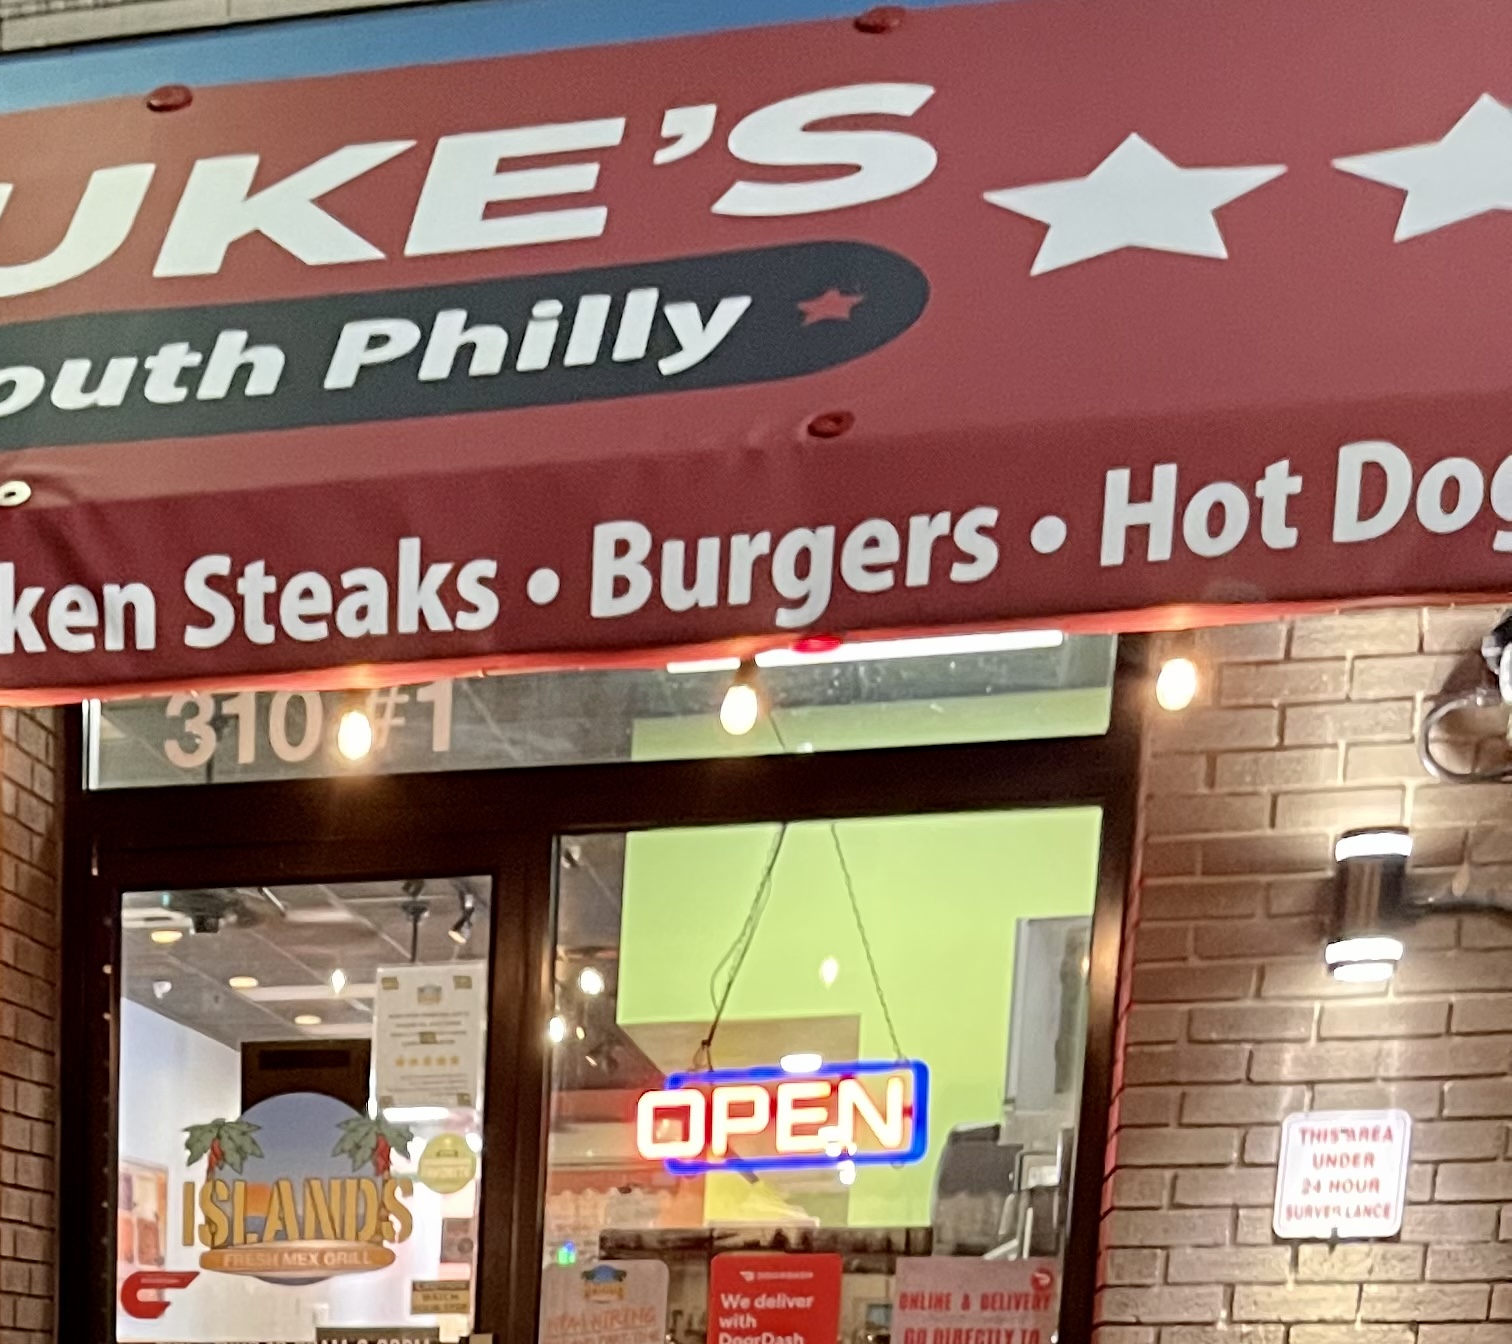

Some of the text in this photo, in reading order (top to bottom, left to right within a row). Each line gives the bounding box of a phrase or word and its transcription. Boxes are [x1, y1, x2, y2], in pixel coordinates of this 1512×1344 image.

[323, 288, 752, 390] Philly
[183, 537, 500, 649] Steaks
[590, 506, 1000, 629] Burgers
[1100, 460, 1303, 567] Hot
[163, 690, 324, 769] 310
[636, 1075, 906, 1160] OPEN
[1312, 1152, 1375, 1169] UNDER
[1328, 1177, 1380, 1194] HOUR
[182, 1176, 414, 1248] ISLANDS
[223, 1251, 372, 1269] FRESH MEX GRILL
[720, 1293, 815, 1309] We deliver
[899, 1292, 952, 1311] ONLINE
[980, 1292, 1051, 1312] DELIVERY
[719, 1313, 757, 1328] with
